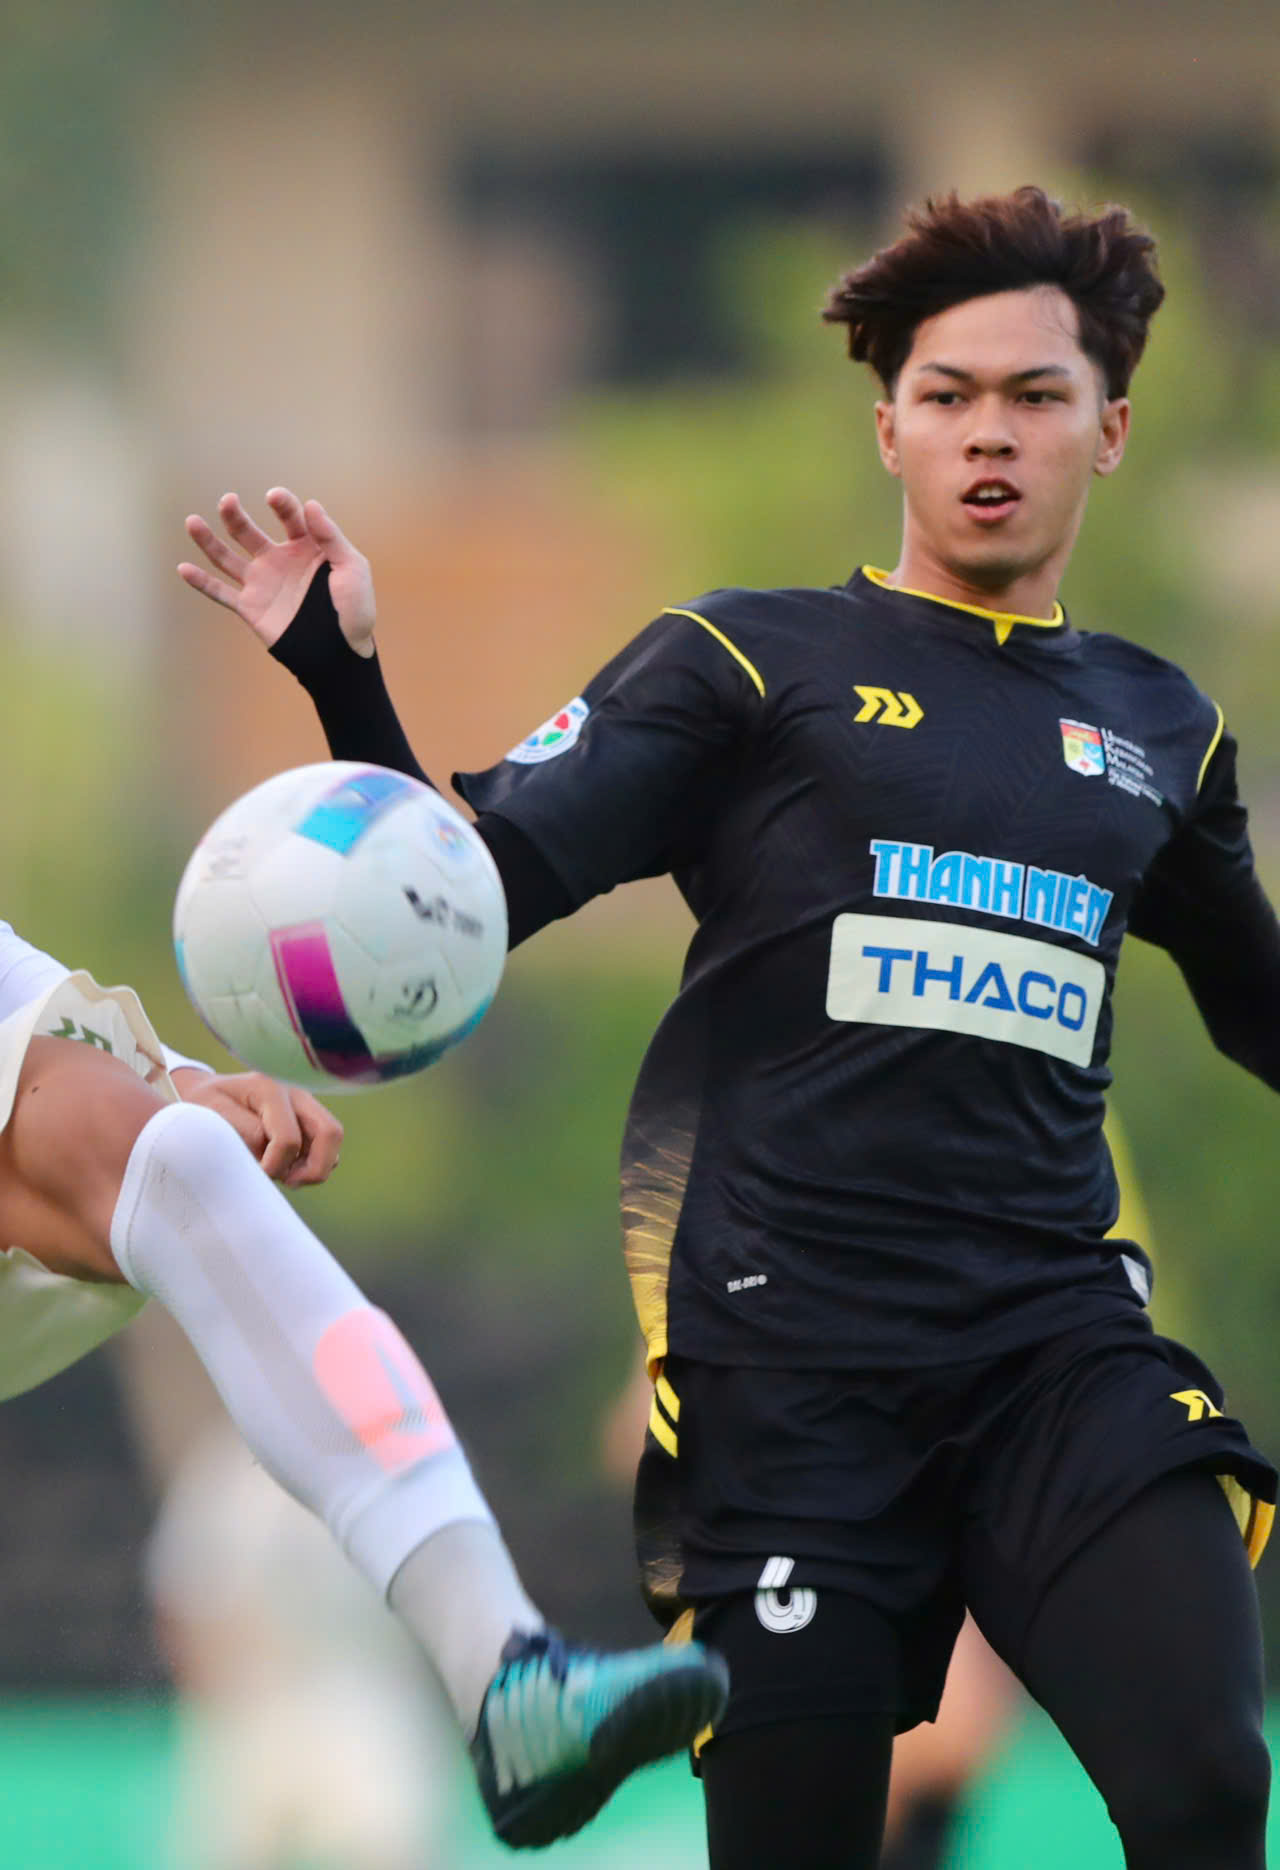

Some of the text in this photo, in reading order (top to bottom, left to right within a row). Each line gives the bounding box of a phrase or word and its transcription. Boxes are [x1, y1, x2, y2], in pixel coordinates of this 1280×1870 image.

[870, 838, 1114, 947] THANH NIÊN
[862, 946, 1087, 1032] THACO
[754, 1555, 817, 1634] 6
